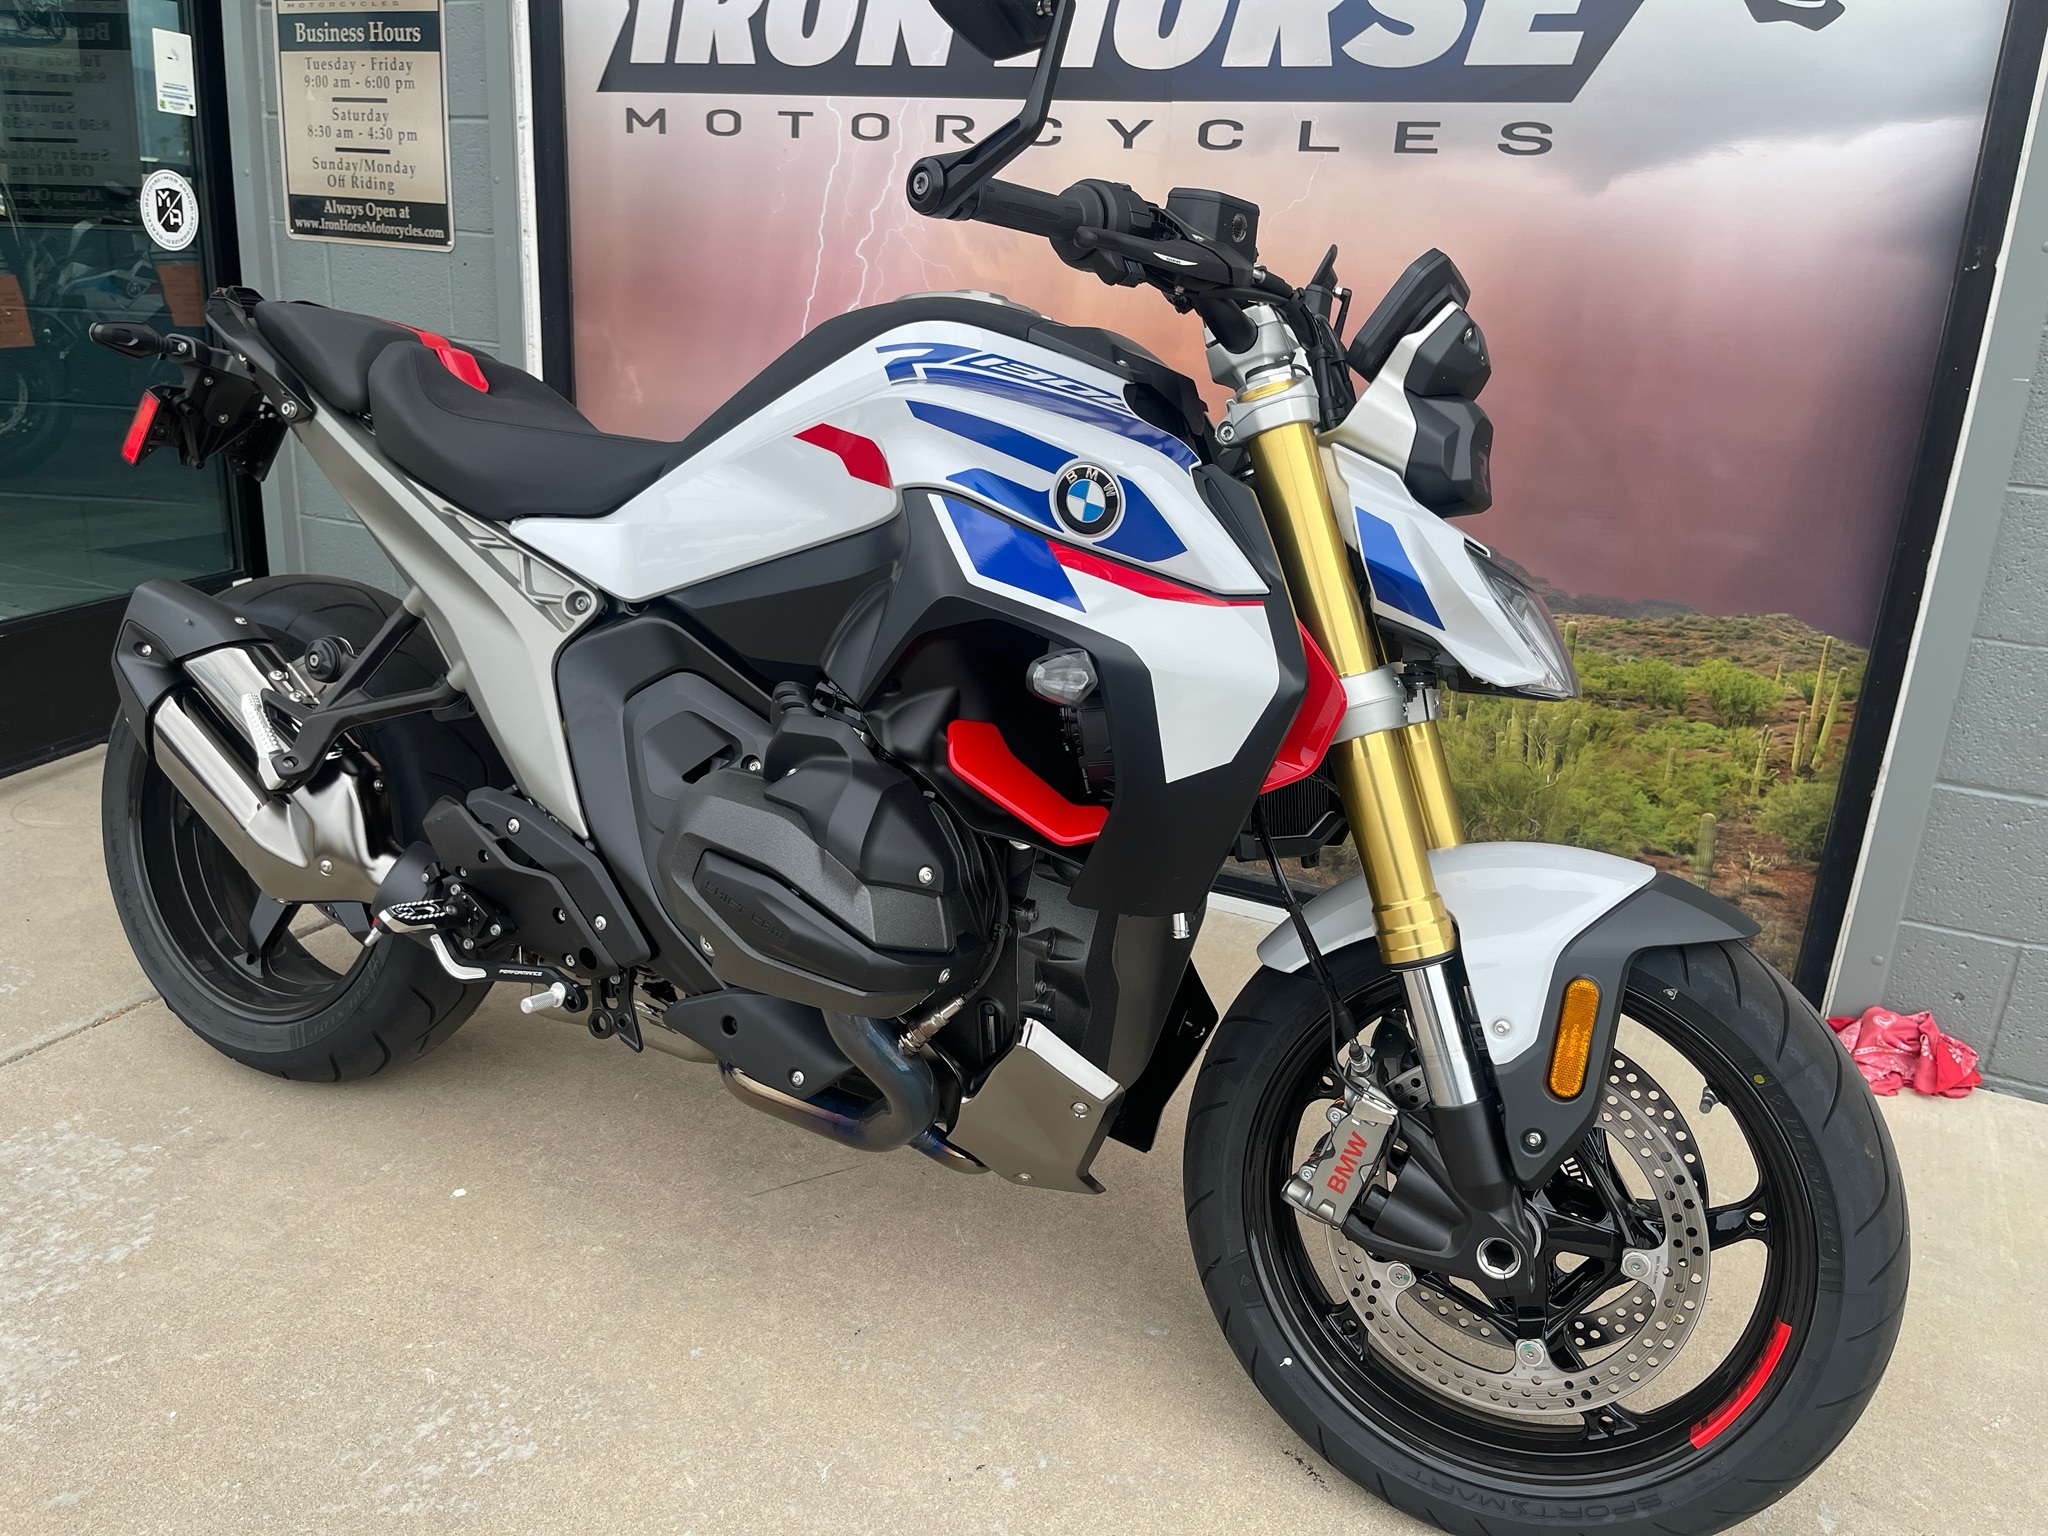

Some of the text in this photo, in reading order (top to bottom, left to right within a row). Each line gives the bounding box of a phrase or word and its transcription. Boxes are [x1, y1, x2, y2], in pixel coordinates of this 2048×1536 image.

[294, 21, 422, 42] Business Hours
[304, 57, 356, 74] Tuesday
[370, 57, 413, 75] Friday
[304, 75, 328, 88] 9:00
[333, 78, 350, 88] am
[364, 76, 390, 89] 6:00
[395, 79, 415, 93] pm
[332, 107, 389, 125] Saturday
[307, 125, 331, 138] 8:30
[336, 128, 353, 139] am
[367, 127, 393, 141] 4:30
[398, 130, 418, 145] pm
[626, 108, 1554, 156] MOTORCYCLES
[312, 156, 416, 179] Sunday/Monday
[327, 174, 395, 195] Off Riding
[324, 200, 410, 221] Always Open at
[295, 217, 445, 239] www.IronHorseMotorcycles.com
[1066, 467, 1116, 497] BMW
[1326, 1131, 1368, 1195] BMW
